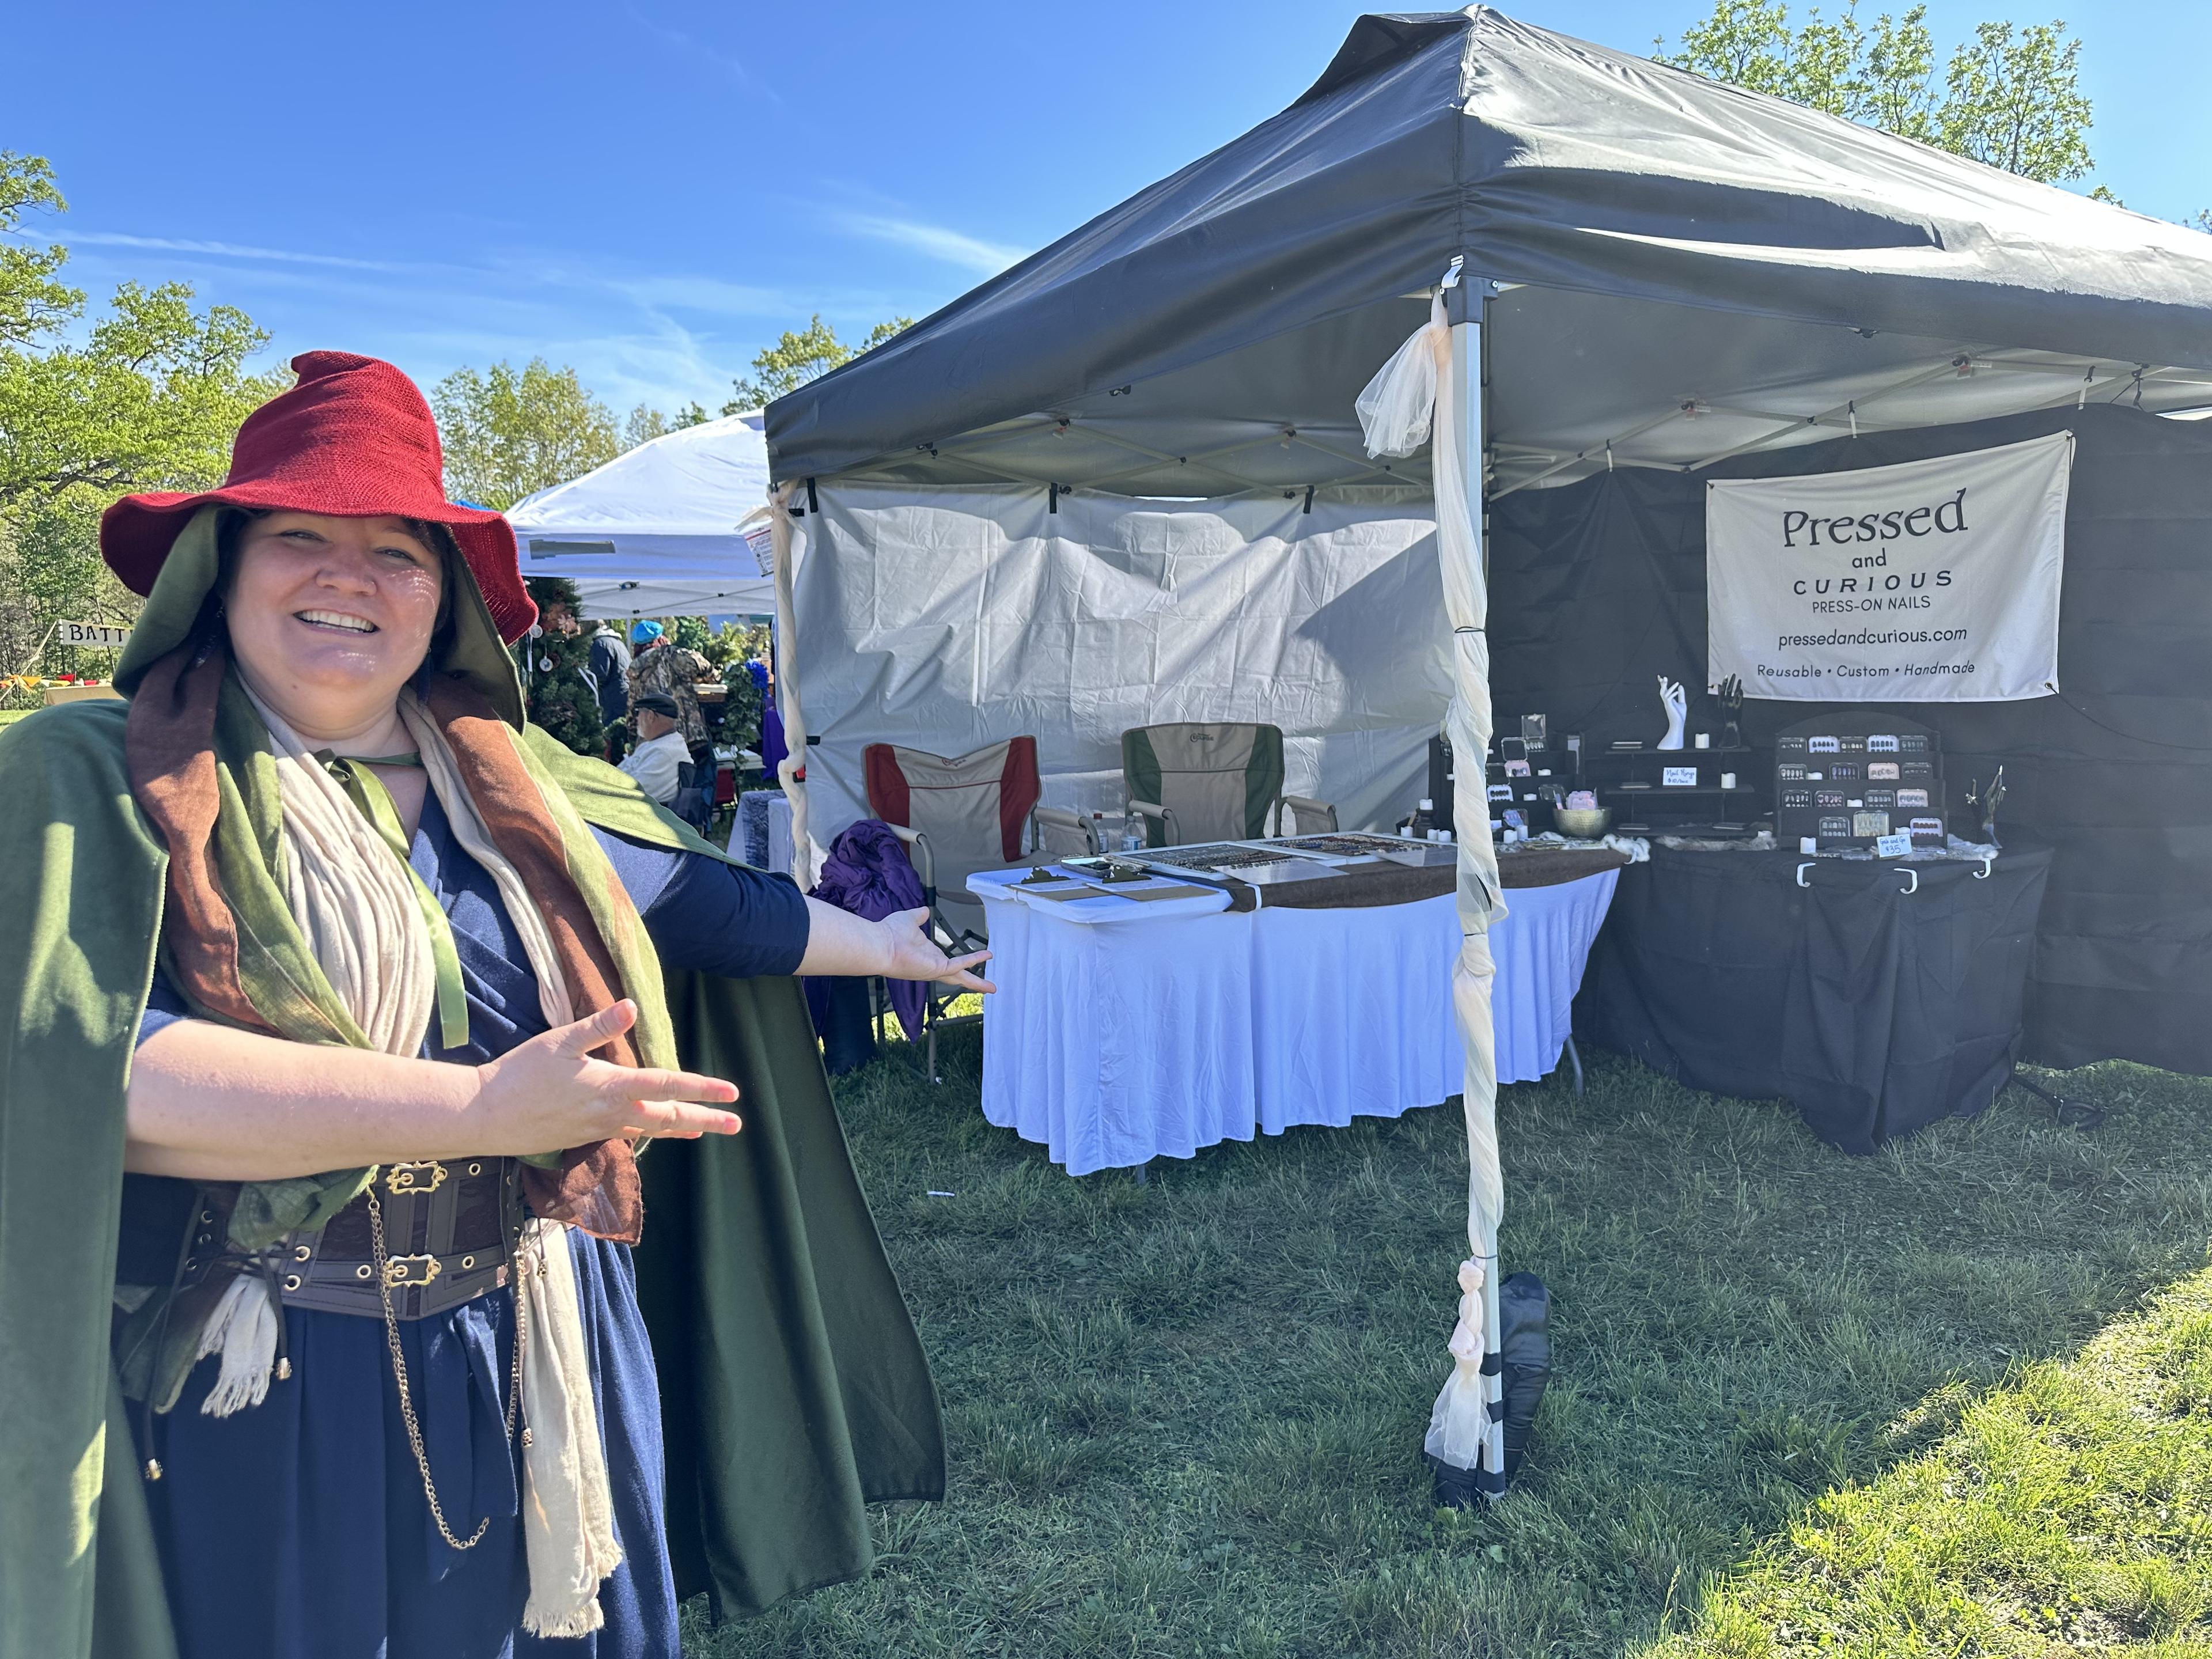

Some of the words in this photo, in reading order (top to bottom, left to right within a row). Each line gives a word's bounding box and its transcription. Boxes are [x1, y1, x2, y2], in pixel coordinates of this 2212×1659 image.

[1783, 487, 1968, 547] Pressed
[1851, 547, 1887, 569] and
[1793, 570, 1952, 596] CURIOUS
[1812, 598, 1884, 614] PRESS-ON
[1888, 595, 1931, 611] NAILS
[69, 624, 133, 642] BATT
[1778, 627, 1968, 651] pressedandcurious.com
[1758, 664, 1822, 678] Reusable
[1836, 664, 1889, 678] Custom
[1904, 659, 1975, 676] Handmade
